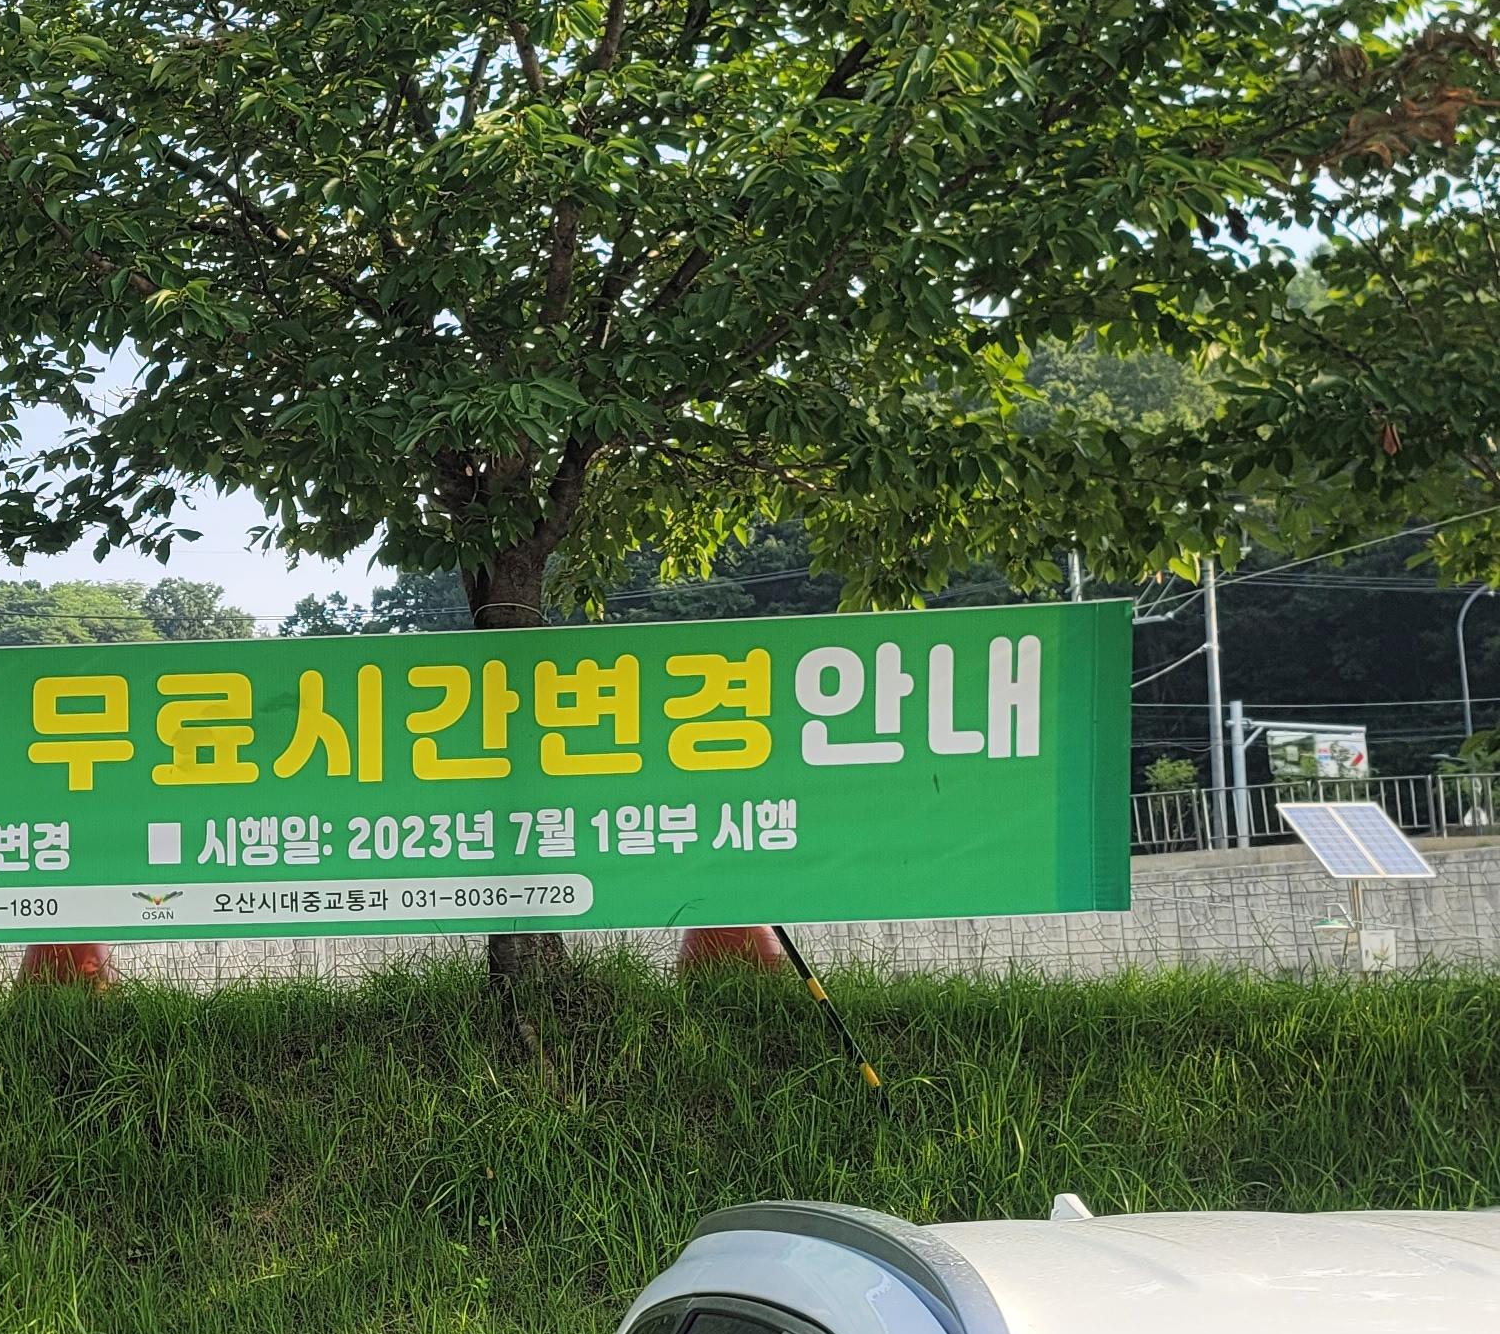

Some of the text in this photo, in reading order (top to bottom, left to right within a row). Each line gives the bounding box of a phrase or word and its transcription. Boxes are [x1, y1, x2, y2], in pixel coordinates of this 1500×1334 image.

[27, 648, 773, 791] 무료시간변경
[794, 634, 1042, 766] 안내
[197, 798, 798, 867] 시행일: 2023년 7월 1일부 시행
[142, 911, 174, 920] OSAN
[213, 885, 575, 914] 오산시대중교통과 031-8036-7728
